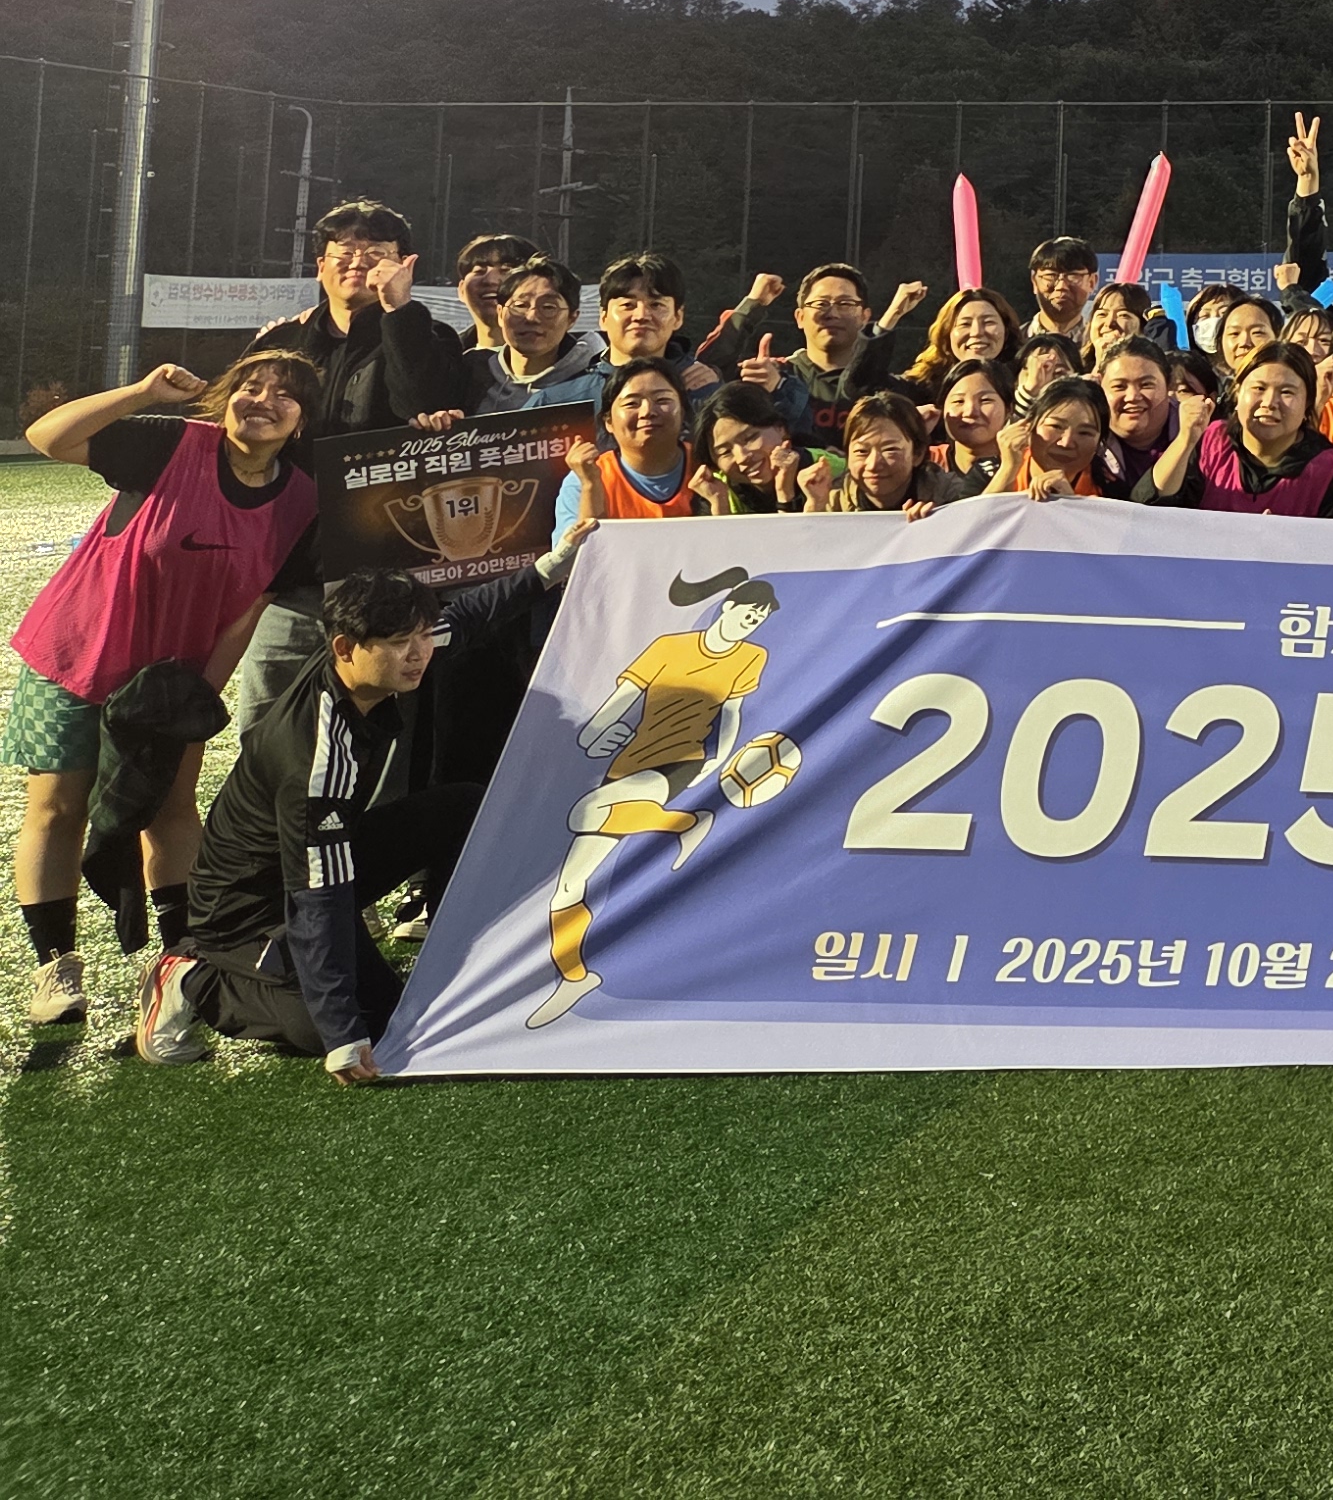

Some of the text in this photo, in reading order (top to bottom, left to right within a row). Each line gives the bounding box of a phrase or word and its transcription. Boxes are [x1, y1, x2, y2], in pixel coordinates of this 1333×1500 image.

[344, 436, 571, 490] 실로암 직원 풋살대회
[399, 428, 517, 458] 2025 Siloam
[446, 496, 480, 519] 1위
[811, 931, 920, 984] 일시
[996, 937, 1188, 988] 2025년
[1206, 942, 1313, 990] 10월
